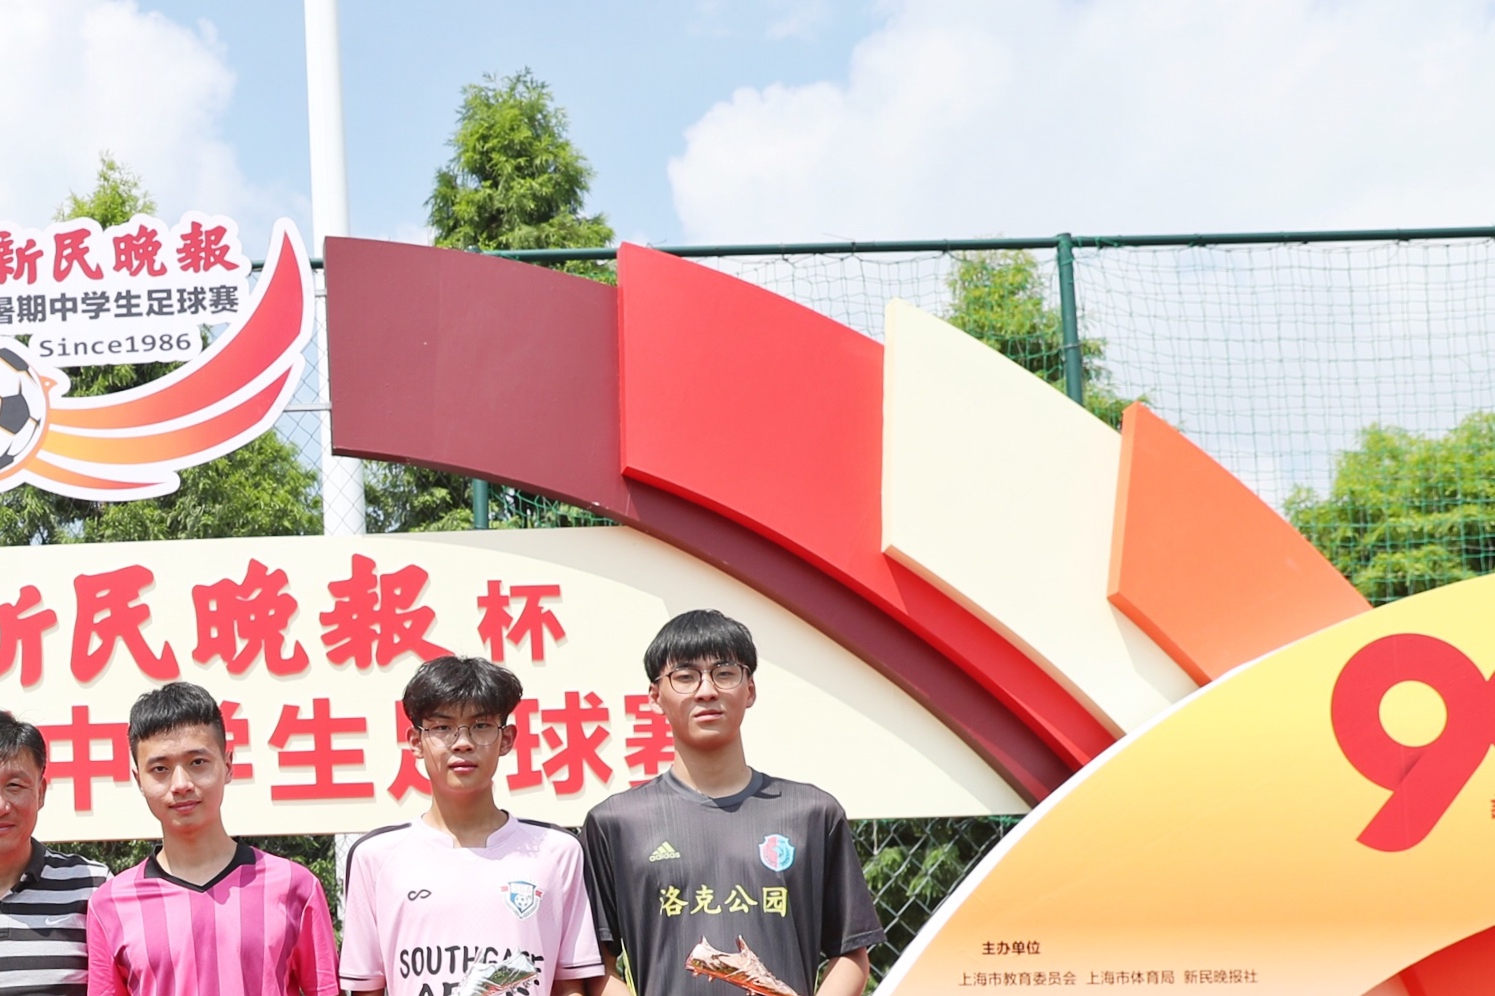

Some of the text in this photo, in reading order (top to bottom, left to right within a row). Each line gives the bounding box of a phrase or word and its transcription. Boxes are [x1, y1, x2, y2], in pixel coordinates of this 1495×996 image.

[39, 333, 192, 357] Since1986
[1331, 633, 1495, 852] 9
[648, 850, 681, 862] adidas
[659, 884, 788, 917] 洛克公园
[982, 941, 1041, 955] 主办单位
[958, 969, 1258, 987] 上海市教育委员会 上海市体育局 新民晚报社
